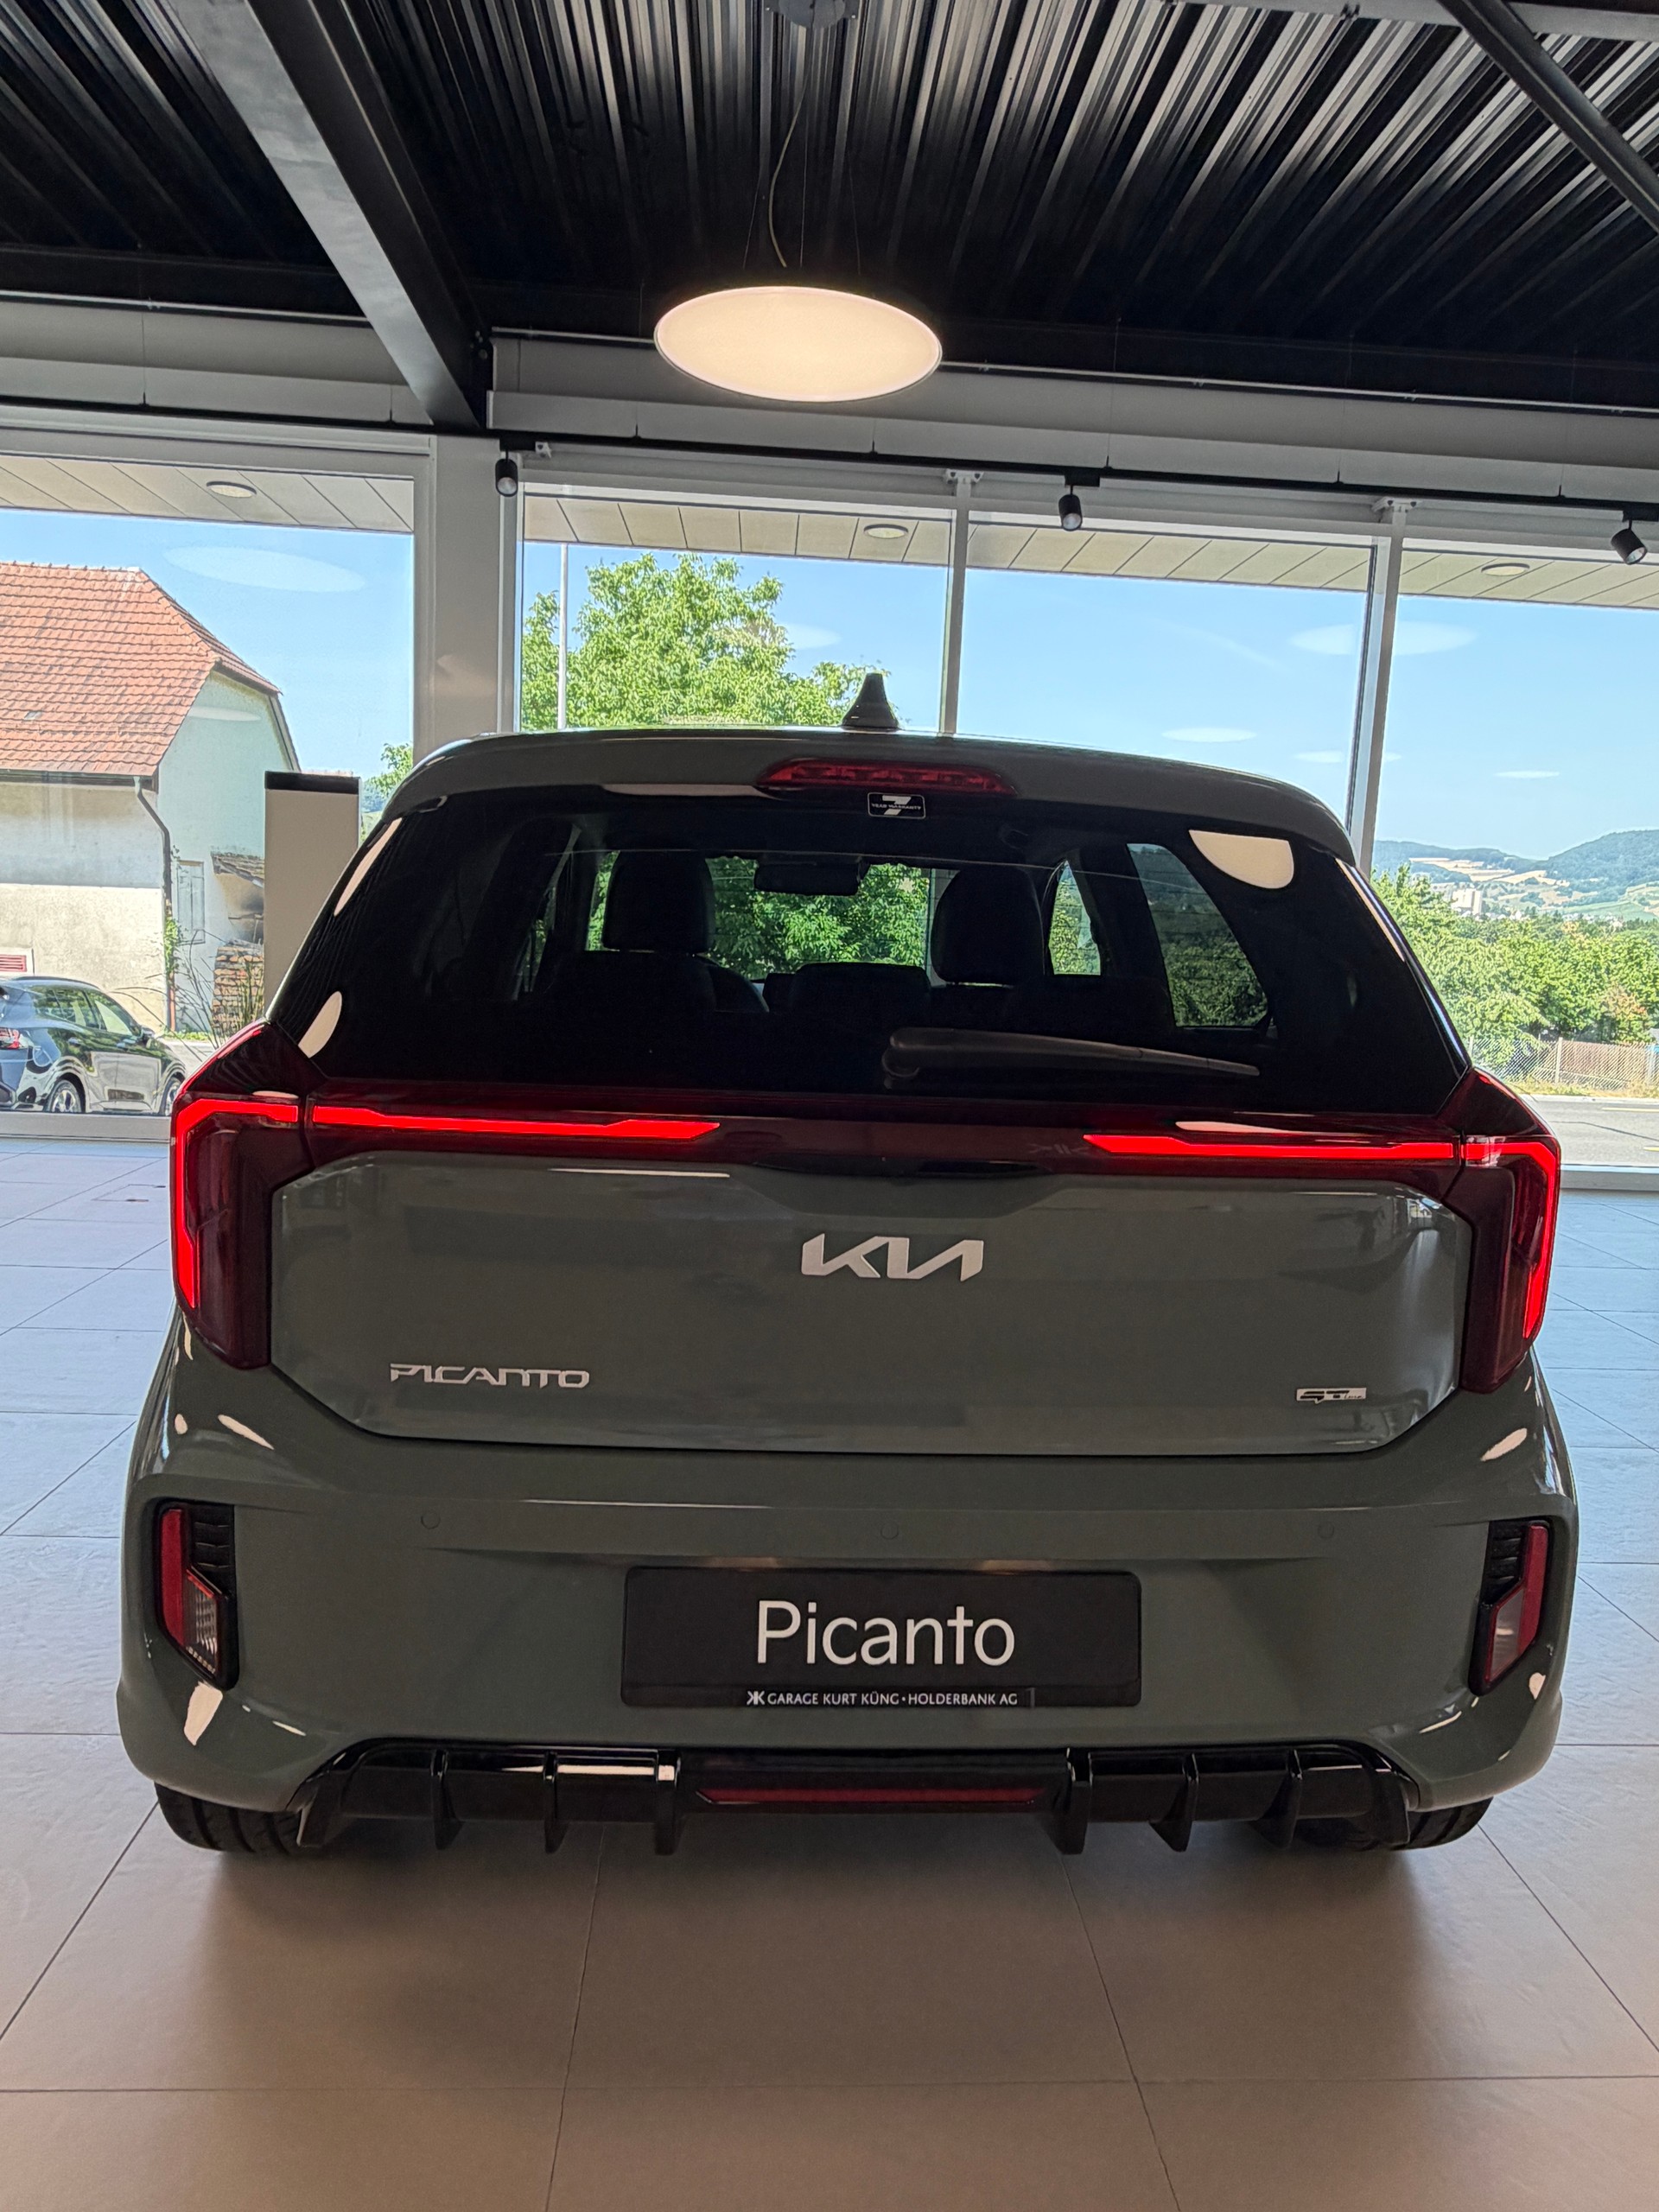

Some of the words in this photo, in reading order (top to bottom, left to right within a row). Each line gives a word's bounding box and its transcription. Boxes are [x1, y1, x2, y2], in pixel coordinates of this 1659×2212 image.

[801, 1233, 984, 1281] KIA
[390, 1363, 589, 1389] PICANTO
[757, 1600, 1015, 1666] Picanto
[767, 1693, 819, 1706] GARAGE
[823, 1693, 857, 1706] KURT
[999, 1693, 1018, 1706] AG
